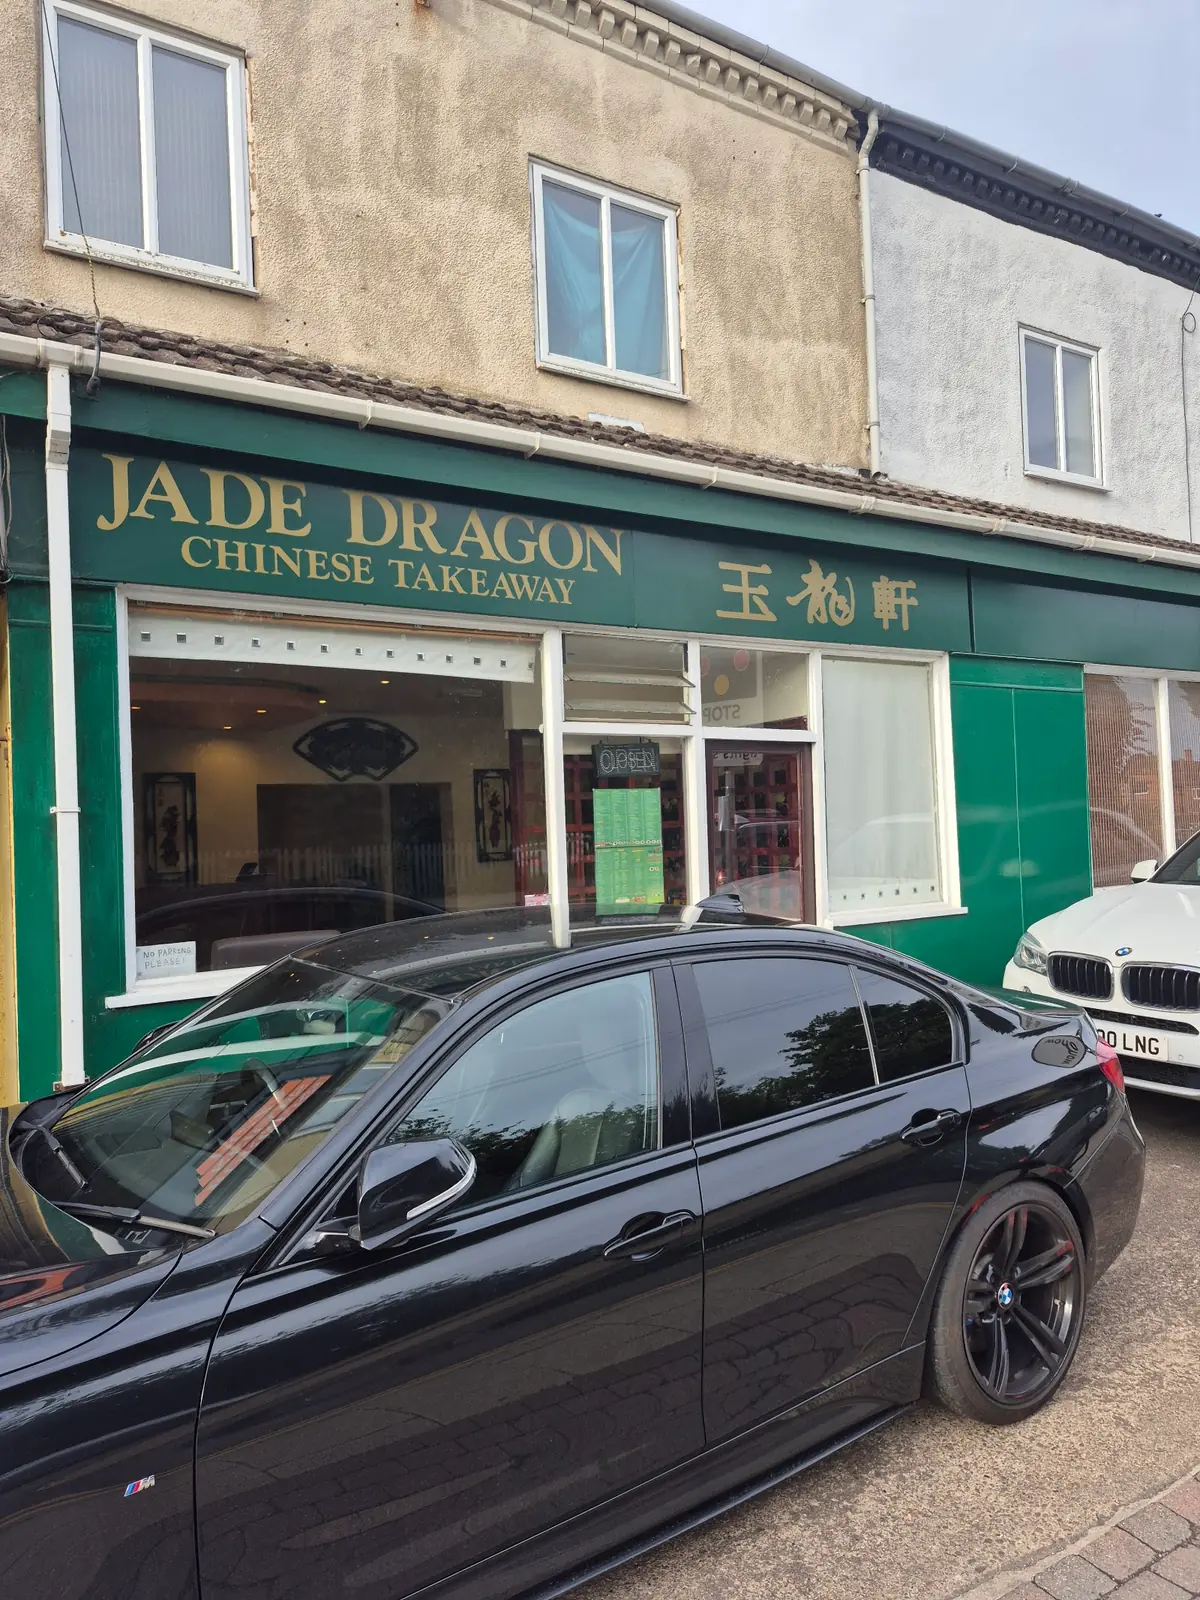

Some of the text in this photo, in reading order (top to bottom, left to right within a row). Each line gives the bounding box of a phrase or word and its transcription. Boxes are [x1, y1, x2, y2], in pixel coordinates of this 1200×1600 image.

[96, 453, 622, 576] JADE DRAGON
[181, 535, 576, 605] CHINESE TAKEAWAY
[145, 957, 185, 969] PLEASE!
[158, 947, 191, 957] PARKING
[1123, 1033, 1160, 1055] LNG
